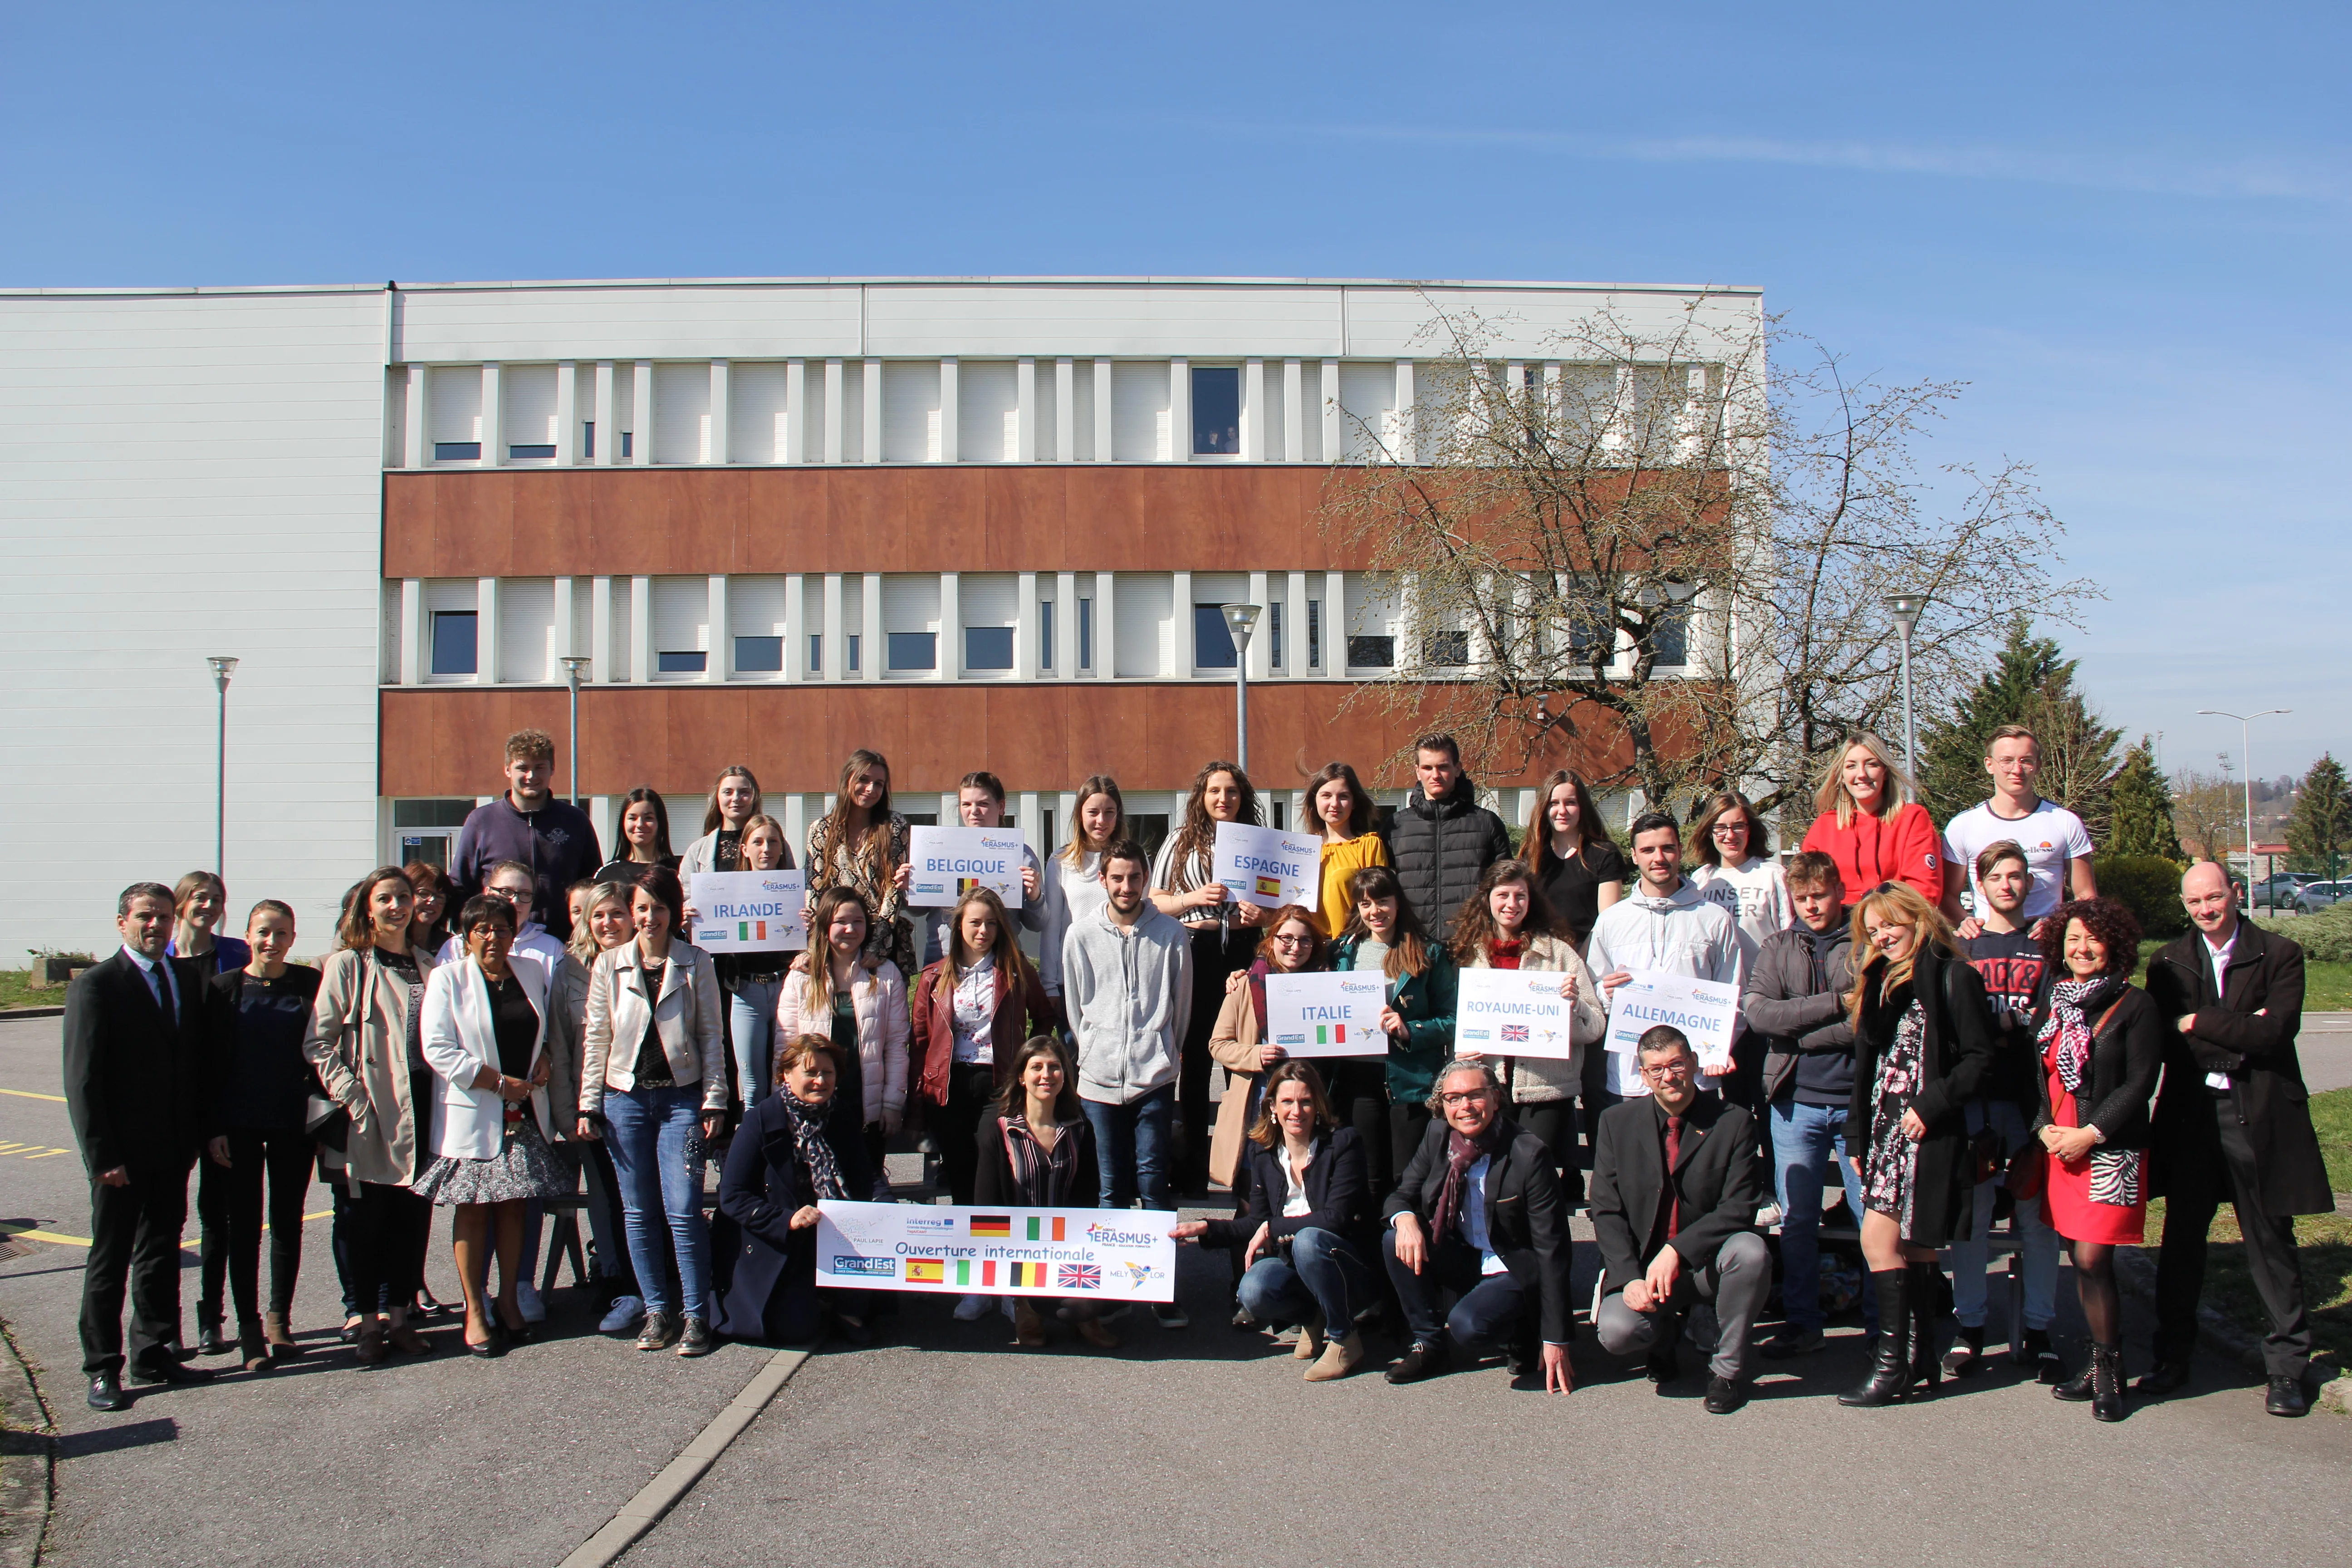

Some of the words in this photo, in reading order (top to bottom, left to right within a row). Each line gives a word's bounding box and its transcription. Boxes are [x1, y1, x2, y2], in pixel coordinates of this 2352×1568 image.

[927, 858, 1005, 875] BELGIQUE
[1234, 855, 1300, 877] ESPAGNE
[714, 903, 783, 918] IRLANDE
[1302, 1005, 1352, 1020] ITALIE
[1467, 1001, 1559, 1016] ROYAUME-UNI
[1622, 1003, 1721, 1032] ALLEMAGNE
[907, 1217, 941, 1226] Interreg
[1094, 1231, 1158, 1244] ERASMUS+
[896, 1241, 976, 1257] Ouverture
[985, 1244, 1094, 1261] internationale
